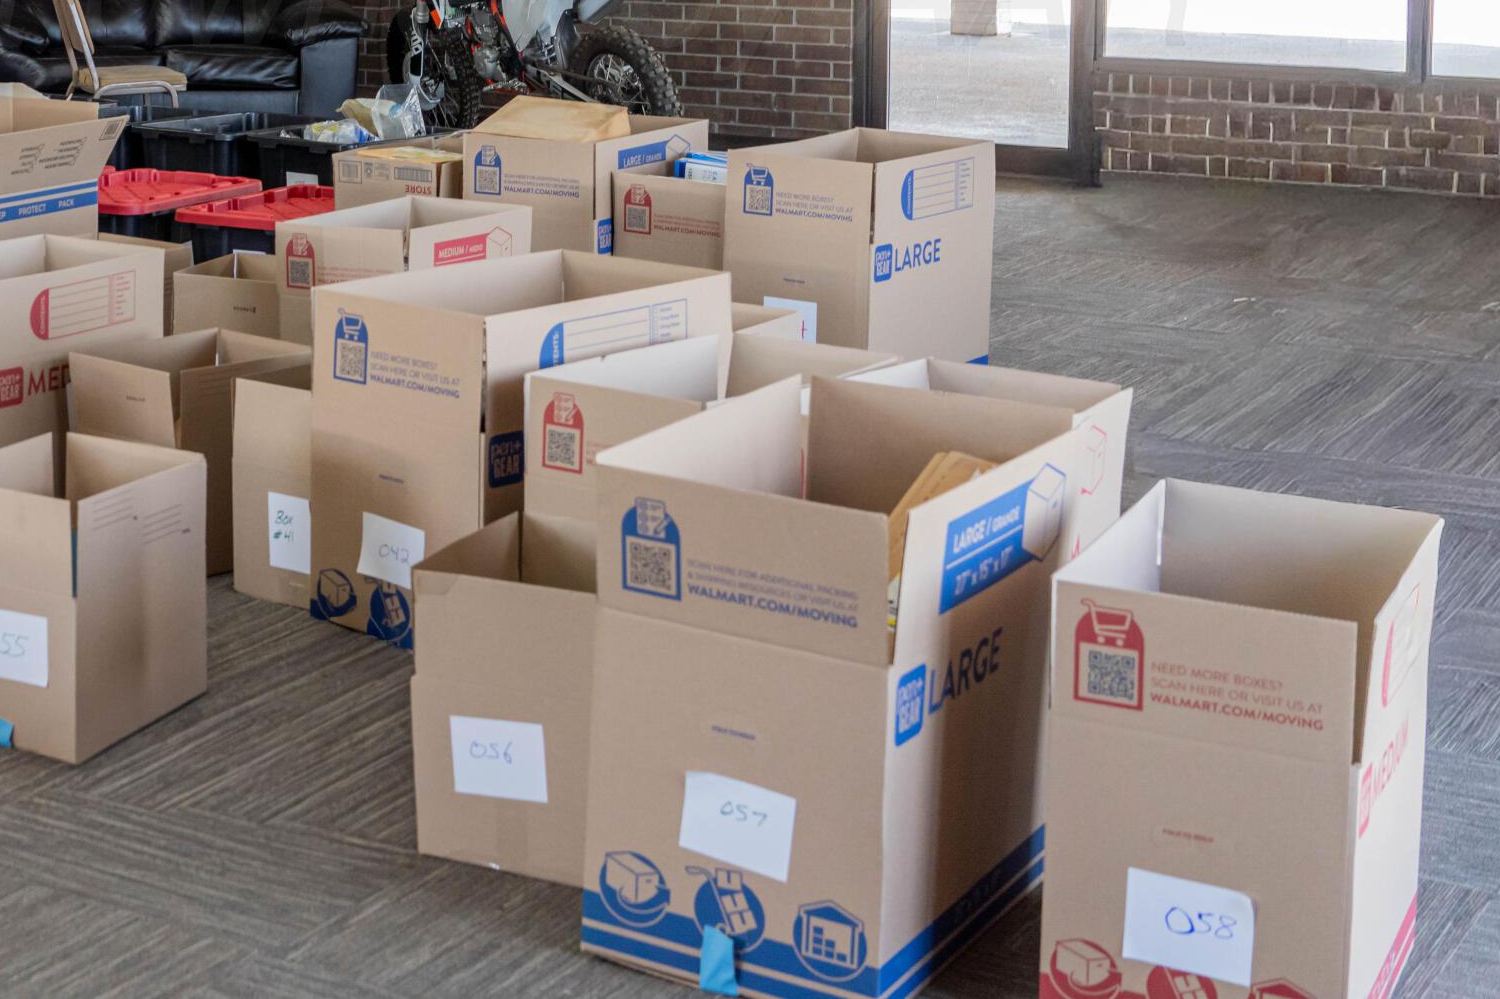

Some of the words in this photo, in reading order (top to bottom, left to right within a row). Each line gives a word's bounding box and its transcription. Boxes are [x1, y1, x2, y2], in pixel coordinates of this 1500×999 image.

[405, 184, 432, 196] STORE
[438, 245, 465, 259] MEDIUM
[895, 238, 942, 272] LARGE
[379, 544, 410, 564] 042
[953, 520, 985, 555] LARGE
[688, 584, 858, 627] WALMART.COM/MOVING
[929, 627, 1002, 714] LARGE
[1151, 661, 1187, 678] NEED
[1190, 667, 1229, 684] MORE
[1233, 673, 1283, 692] BOXES?
[1150, 692, 1324, 731] WALMART.COM/MOVING
[1151, 676, 1187, 692] SCAN
[1190, 682, 1224, 698] HERE
[1228, 688, 1249, 703] OR
[1252, 693, 1283, 708] VISIT
[1286, 698, 1305, 712] US
[1307, 702, 1323, 715] AT
[468, 740, 513, 765] 056
[719, 801, 768, 828] 057
[1165, 906, 1238, 939] 058
